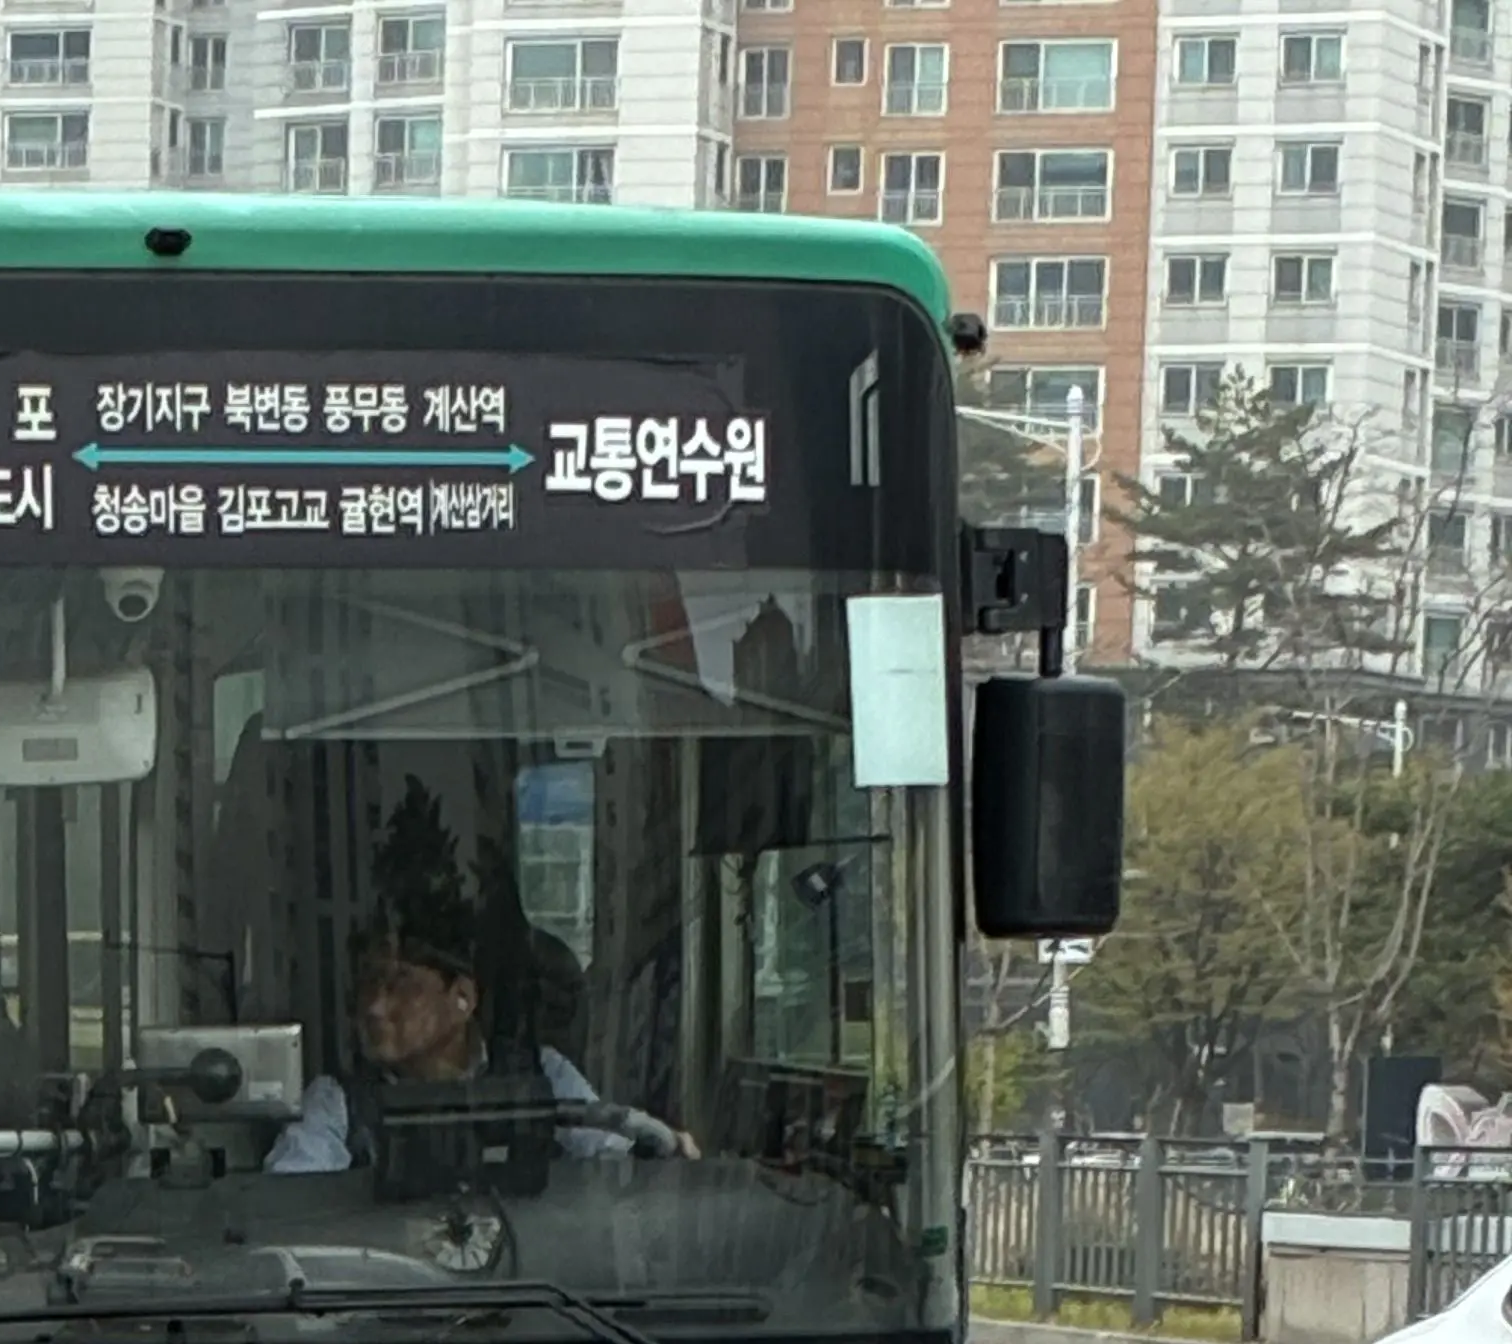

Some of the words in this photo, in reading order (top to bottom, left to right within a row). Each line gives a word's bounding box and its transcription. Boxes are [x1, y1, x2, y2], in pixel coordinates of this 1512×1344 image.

[97, 383, 211, 431] 장기지구
[224, 384, 310, 432] 북변동
[324, 386, 409, 432] 풍무동
[424, 386, 504, 432] 계산역
[546, 417, 765, 501] 교통연수원
[93, 485, 206, 533] 청송마을
[218, 486, 330, 532] 김포고교
[340, 485, 422, 534] 귤현역
